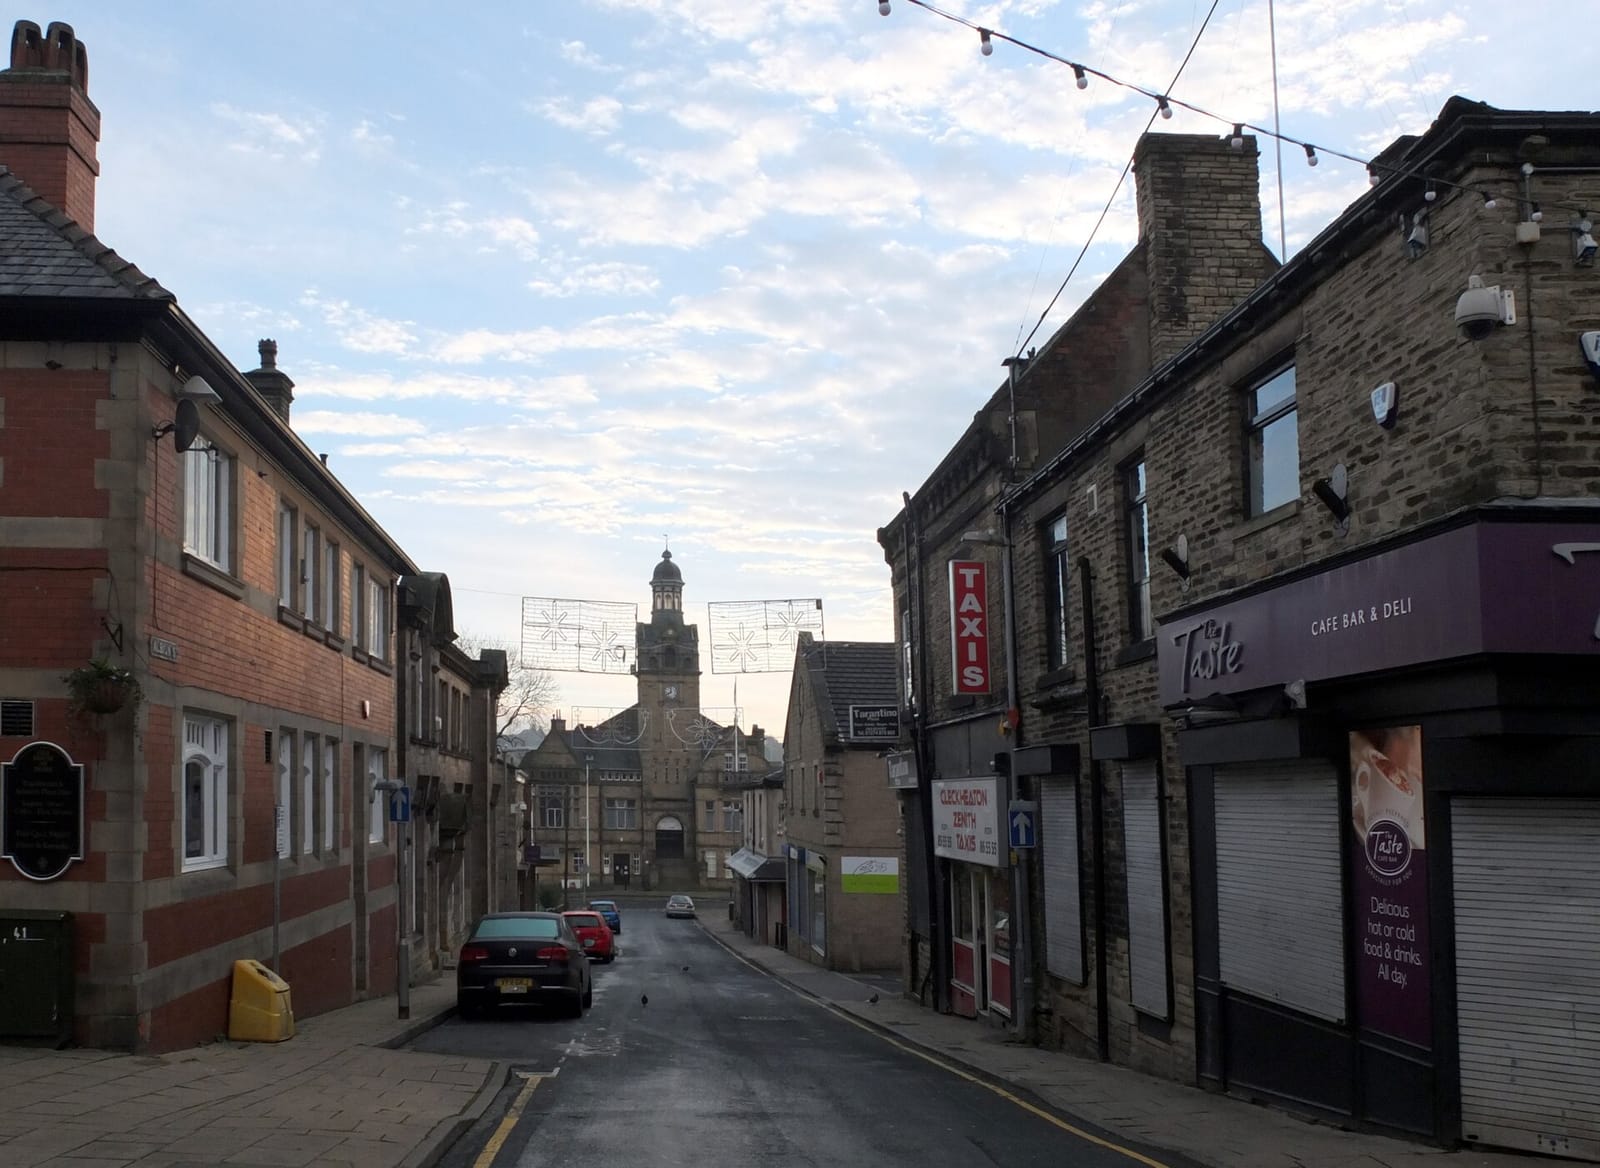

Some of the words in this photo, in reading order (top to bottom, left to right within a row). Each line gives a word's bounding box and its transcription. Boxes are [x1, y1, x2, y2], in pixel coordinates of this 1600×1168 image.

[959, 568, 985, 687] TAXIS
[1311, 616, 1339, 636] CAFE
[1342, 609, 1365, 628] BAR
[1370, 606, 1378, 622] &
[1383, 597, 1411, 619] DELI
[1169, 620, 1243, 693] Taste
[854, 708, 897, 719] Tarantino
[940, 788, 988, 806] CLECKHEATON
[952, 811, 977, 829] ZENITH
[956, 833, 976, 852] TAXIS
[1369, 831, 1403, 860] Taste
[1370, 896, 1410, 919] Delicious
[1367, 917, 1382, 936] hot
[1383, 925, 1395, 938] or
[1396, 923, 1415, 942] cold
[1364, 938, 1382, 958] food
[1384, 942, 1392, 960] &
[1394, 945, 1423, 966] drinks.
[1377, 963, 1390, 981] All
[1391, 966, 1408, 990] day.
